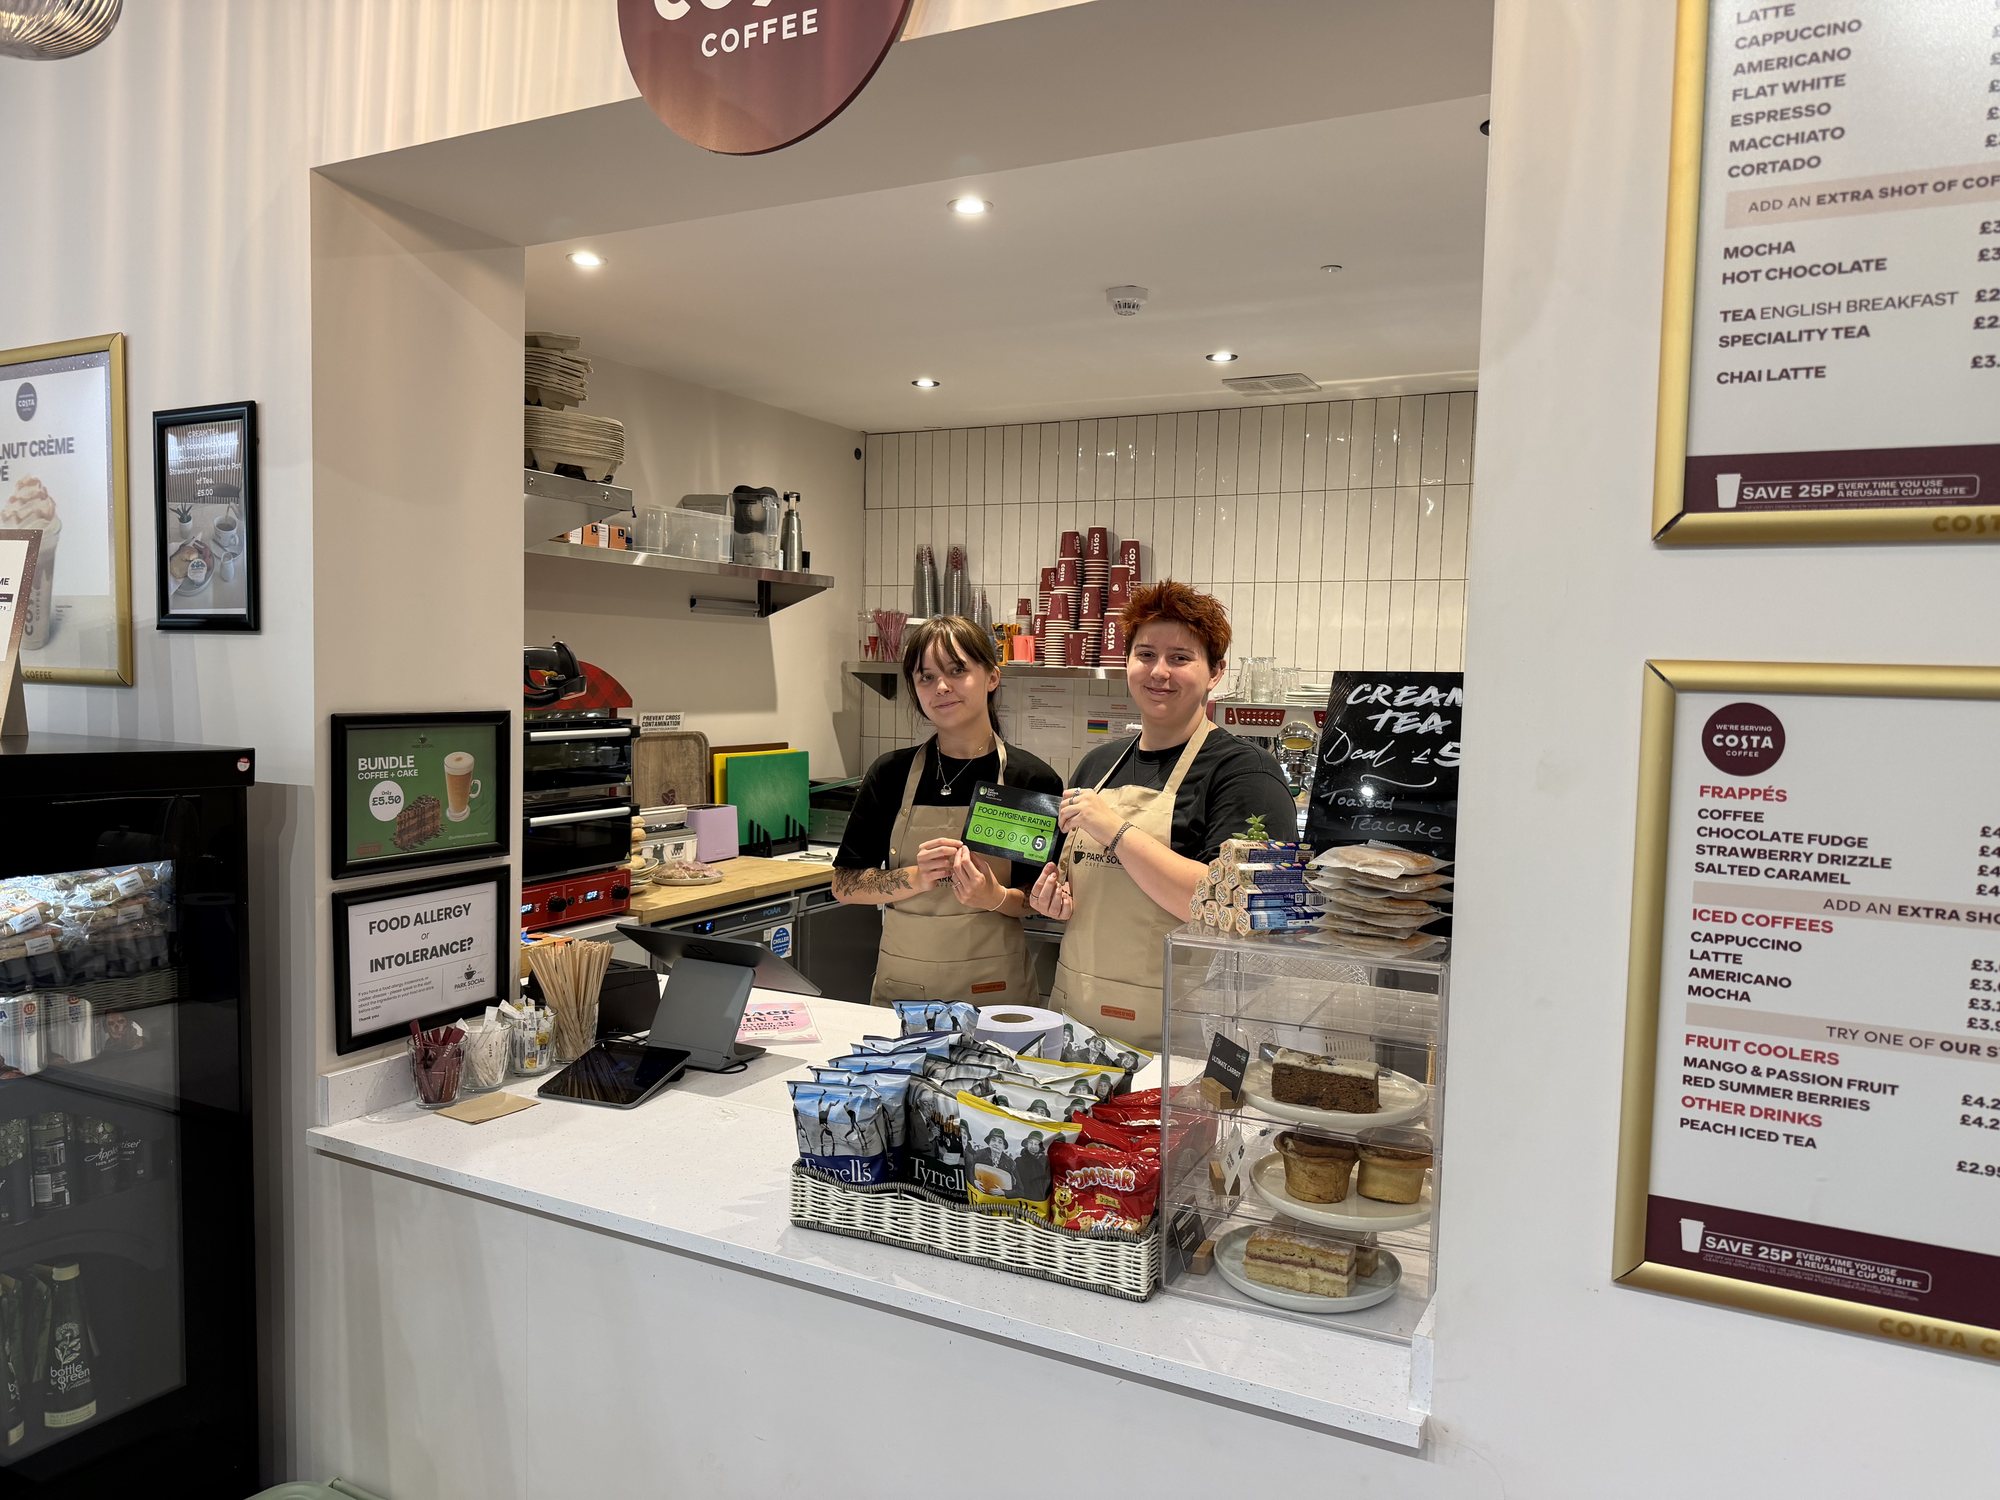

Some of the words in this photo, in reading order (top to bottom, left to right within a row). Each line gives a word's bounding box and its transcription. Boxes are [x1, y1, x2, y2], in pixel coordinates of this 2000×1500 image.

[1736, 3, 1796, 25] LATTE
[701, 8, 818, 58] COFFEE
[1735, 19, 1862, 50] CAPPUCCINO
[1733, 47, 1851, 76] AMERICANO
[1732, 83, 1778, 101] FLAT
[1782, 74, 1846, 96] WHITE
[1730, 102, 1831, 127] ESPRESSO
[1729, 126, 1845, 153] MACCHIATO
[1728, 155, 1821, 179] CORTADO
[1748, 198, 1783, 213] ADD
[1787, 196, 1811, 208] AN
[1816, 189, 1874, 206] EXTRA
[1878, 183, 1929, 199] SHOT
[1932, 179, 1959, 193] OF
[1723, 241, 1796, 260] MOCHA
[1721, 269, 1762, 285] HOT
[1765, 258, 1888, 281] CHOCOLATE
[1720, 308, 1756, 323] TEA
[1760, 300, 1841, 321] ENGLISH
[1846, 291, 1959, 313] BREAKFAST
[1718, 328, 1828, 348] SPECIALITY
[1832, 325, 1870, 340] TEA
[1717, 370, 1762, 385] CHAI
[1766, 366, 1827, 382] LATTE
[18, 399, 35, 408] COSTA
[29, 434, 75, 458] CRÈME
[169, 467, 200, 476] Strawberry
[201, 465, 212, 473] Jam
[197, 488, 213, 497] £5.00
[1742, 486, 1793, 500] SAVE
[1798, 484, 1835, 498] 25P
[1837, 482, 1870, 491] EVERY
[1872, 481, 1896, 489] TIME
[1898, 480, 1921, 488] YOU
[1922, 479, 1943, 488] USE
[1846, 488, 1900, 497] REUSABLE
[1901, 488, 1923, 496] CUP
[1924, 487, 1941, 496] ON
[25, 671, 54, 680] COFFEE
[1366, 708, 1452, 734] TEA
[1323, 724, 1396, 768] Deal
[1712, 734, 1774, 750] COSTA
[358, 755, 415, 771] BUNDLE
[1726, 750, 1759, 758] COFFEE
[358, 770, 389, 780] COFFEE
[397, 769, 419, 778] CAKE
[372, 795, 402, 807] £5.50
[1320, 788, 1395, 811] Toasted
[1699, 785, 1788, 803] FRAPPÉS
[978, 806, 998, 816] FOOD
[999, 810, 1027, 822] HYGIENE
[1027, 816, 1051, 828] RATING
[1350, 814, 1443, 840] Teacake
[1697, 808, 1765, 823] COFFEE
[1696, 826, 1804, 845] CHOCOLATE
[1807, 833, 1868, 849] FUDGE
[1086, 853, 1105, 863] PARK
[1695, 844, 1814, 864] STRAWBERRY
[1817, 853, 1892, 870] DRIZZLE
[1694, 862, 1761, 878] SALTED
[1764, 867, 1851, 885] CARAMEL
[368, 915, 411, 935] FOOD
[413, 902, 472, 926] ALLERGY
[1692, 908, 1738, 924] ICED
[1741, 913, 1834, 934] COFFEES
[1823, 898, 1861, 913] ADD
[1866, 901, 1892, 916] AN
[1897, 905, 1961, 922] EXTRA
[421, 931, 430, 940] or
[773, 936, 789, 945] CHILLER
[1690, 931, 1802, 953] CAPPUCCINO
[369, 936, 474, 973] INTOLERANCE?
[1689, 949, 1743, 965] LATTE
[1971, 958, 2000, 973] £3.
[454, 981, 467, 990] PARK
[467, 977, 486, 987] SOCIAL
[1688, 967, 1792, 989] AMERICANO
[1687, 985, 1751, 1003] MOCHA
[1685, 1033, 1741, 1052] FRUIT
[1744, 1041, 1840, 1066] COOLERS
[1825, 1025, 1859, 1041] TRY
[1864, 1030, 1904, 1047] ONE
[1909, 1036, 1935, 1050] OF
[1939, 1039, 1981, 1056] OUR
[1683, 1056, 1747, 1075] MANGO
[1750, 1064, 1762, 1077] &
[1765, 1067, 1843, 1089] PASSION
[1846, 1079, 1899, 1096] FRUIT
[1682, 1074, 1715, 1089] RED
[1718, 1079, 1793, 1101] SUMMER
[1797, 1090, 1871, 1112] BERRIES
[1681, 1095, 1746, 1117] OTHER
[1749, 1105, 1823, 1128] DRINKS
[1679, 1117, 1737, 1137] PEACH
[1740, 1127, 1779, 1143] ICED
[1782, 1133, 1817, 1150] TEA
[1705, 1236, 1753, 1256] SAVE
[1758, 1246, 1793, 1263] 25P
[1795, 1258, 1803, 1266] A
[1804, 1260, 1855, 1277] REUSABLE
[1857, 1269, 1878, 1281] CUP
[1878, 1273, 1895, 1284] ON
[1796, 1251, 1828, 1264] EVERY
[1829, 1257, 1853, 1268] TIME
[1854, 1261, 1875, 1273] YOU
[1876, 1266, 1897, 1277] USE
[1878, 1317, 1968, 1350] COSTA
[50, 1363, 82, 1378] bottle
[57, 1367, 90, 1394] green
